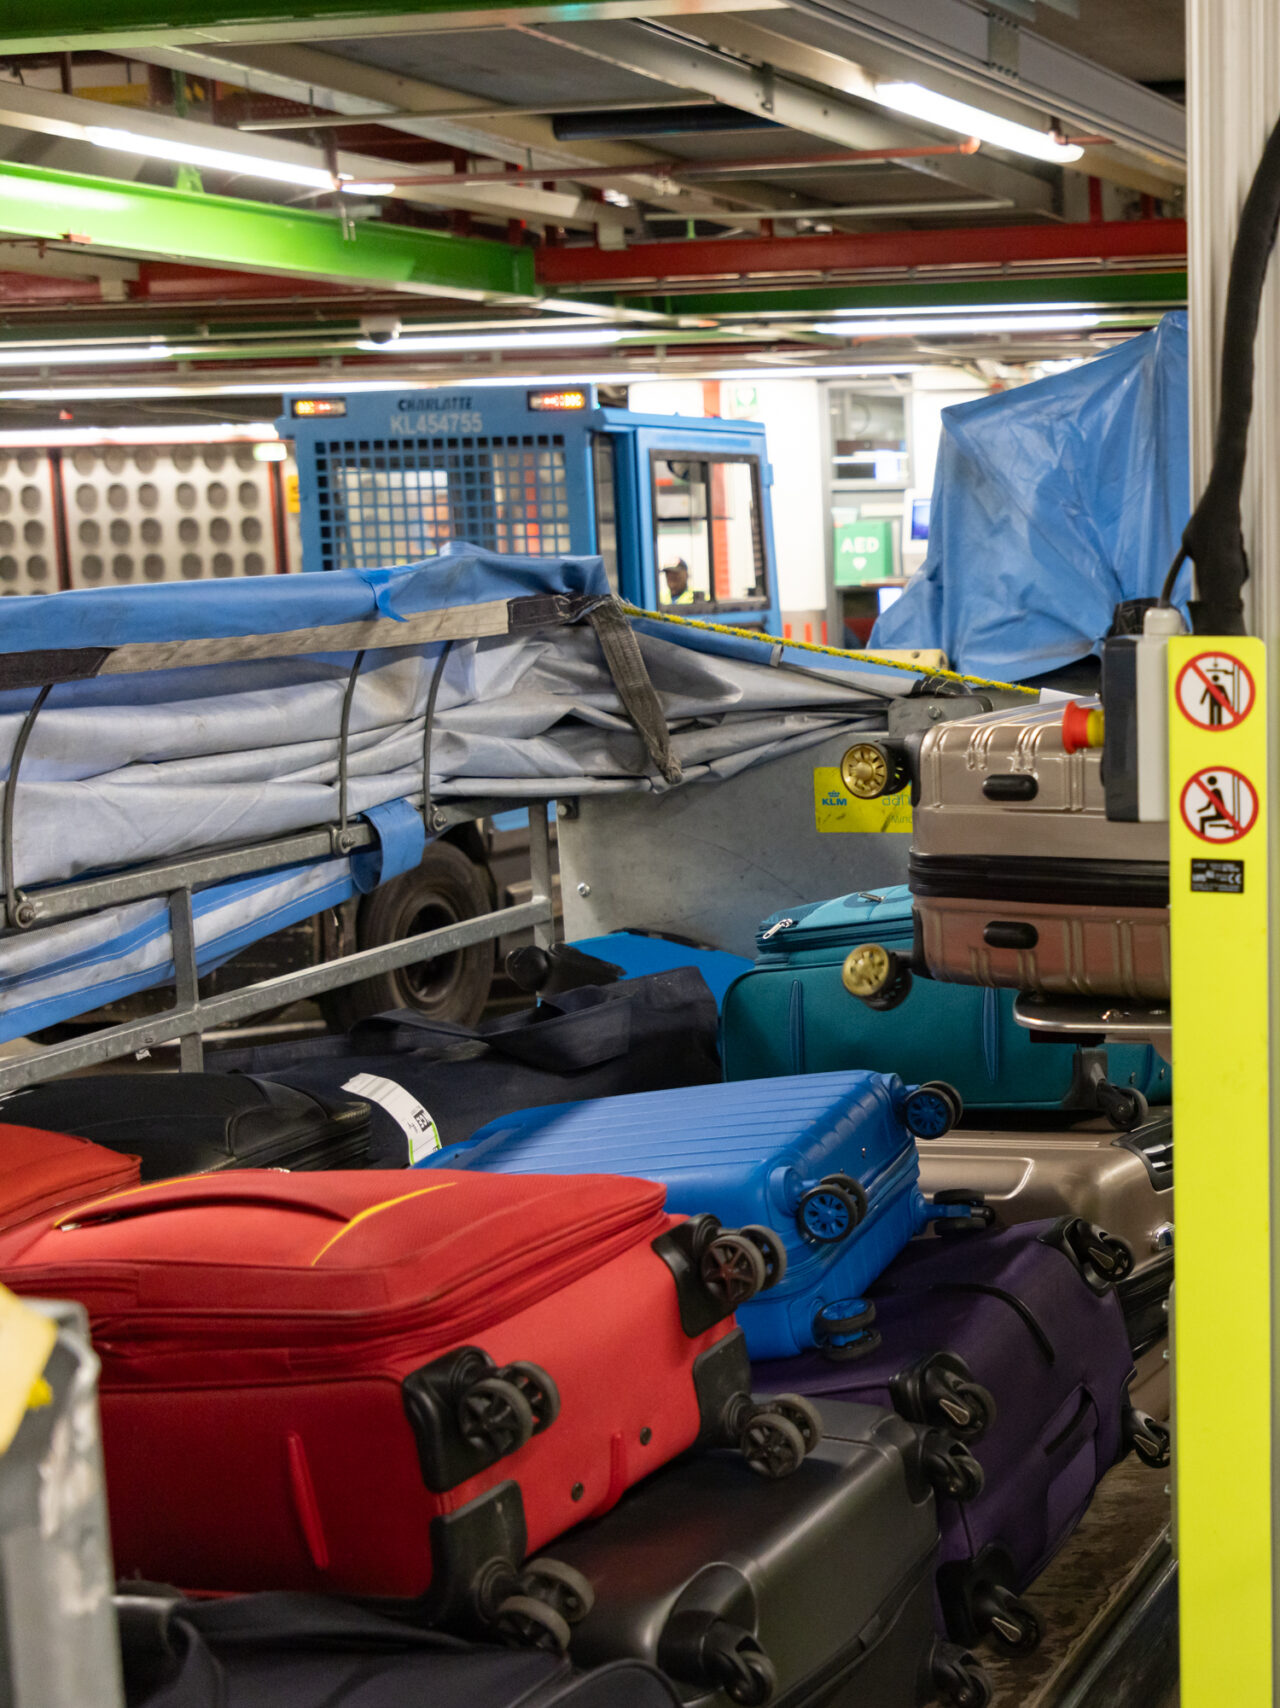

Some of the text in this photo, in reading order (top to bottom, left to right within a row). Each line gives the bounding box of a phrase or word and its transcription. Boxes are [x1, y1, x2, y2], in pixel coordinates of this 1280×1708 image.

[389, 412, 483, 434] KL454755
[840, 536, 880, 553] AED
[821, 798, 847, 806] KLM
